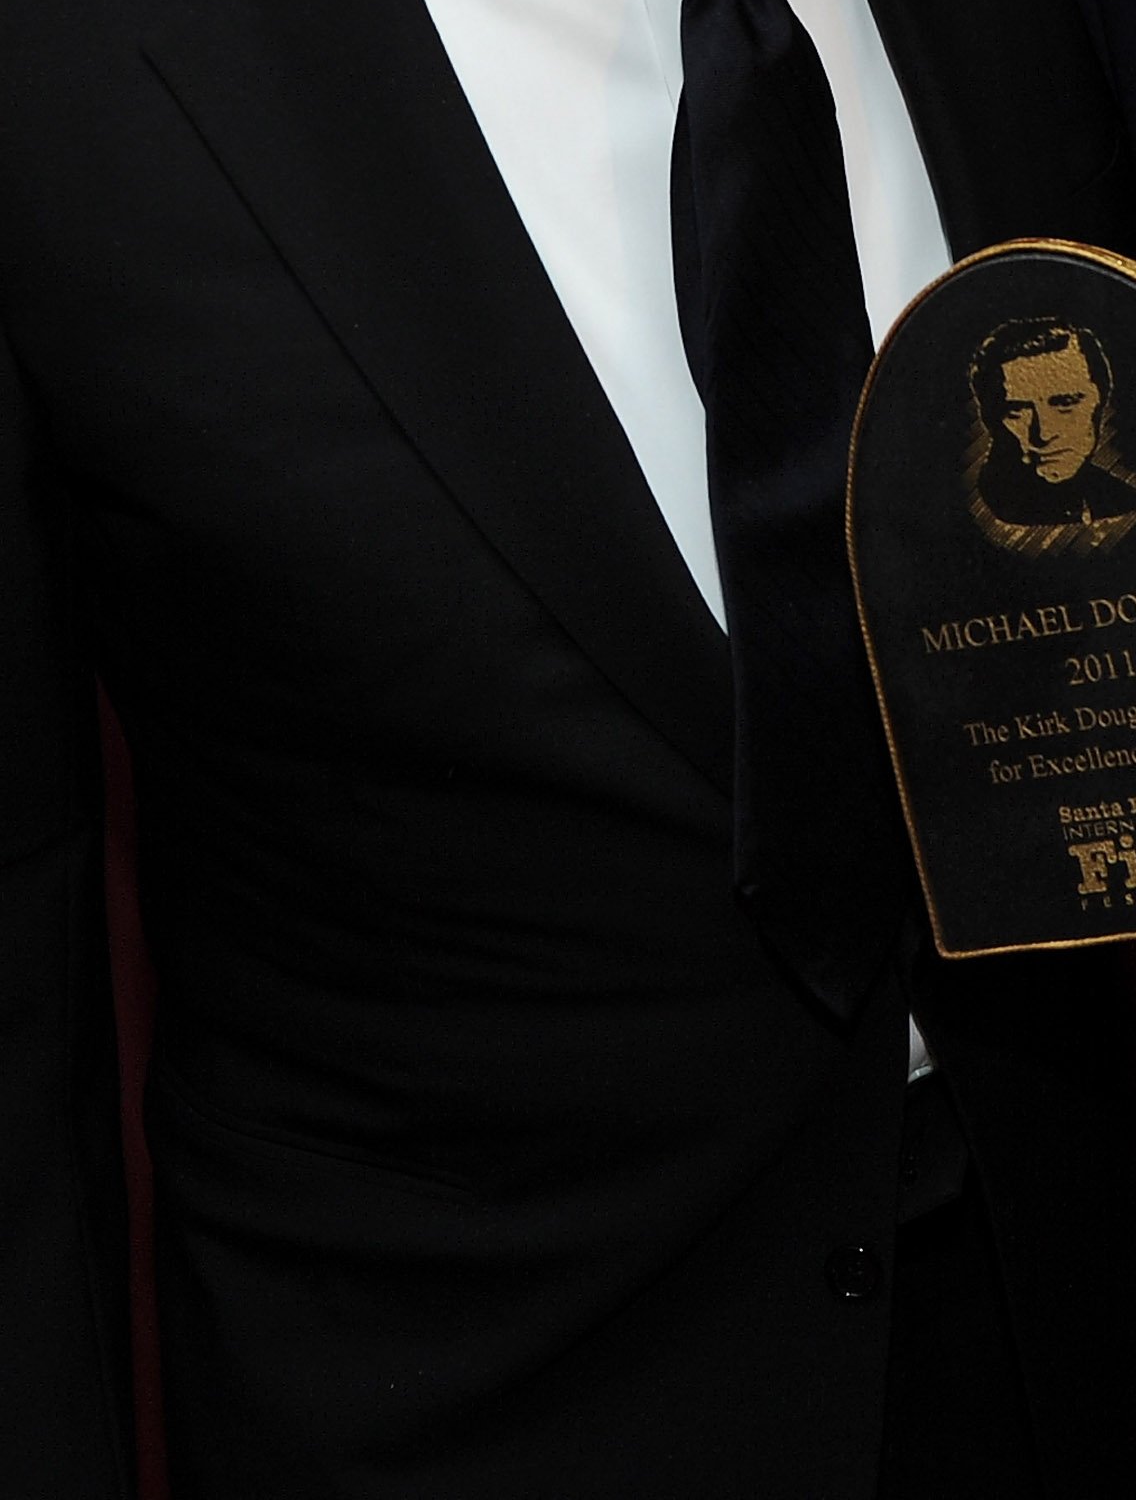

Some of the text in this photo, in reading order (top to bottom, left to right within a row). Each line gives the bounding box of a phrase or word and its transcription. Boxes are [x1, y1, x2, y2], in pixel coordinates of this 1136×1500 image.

[921, 606, 1083, 654] MICHAEL
[1065, 649, 1136, 685] 2011
[963, 723, 1010, 748] The
[1014, 712, 1070, 740] Kirk
[989, 761, 1022, 784] for
[1058, 800, 1124, 823] Santa
